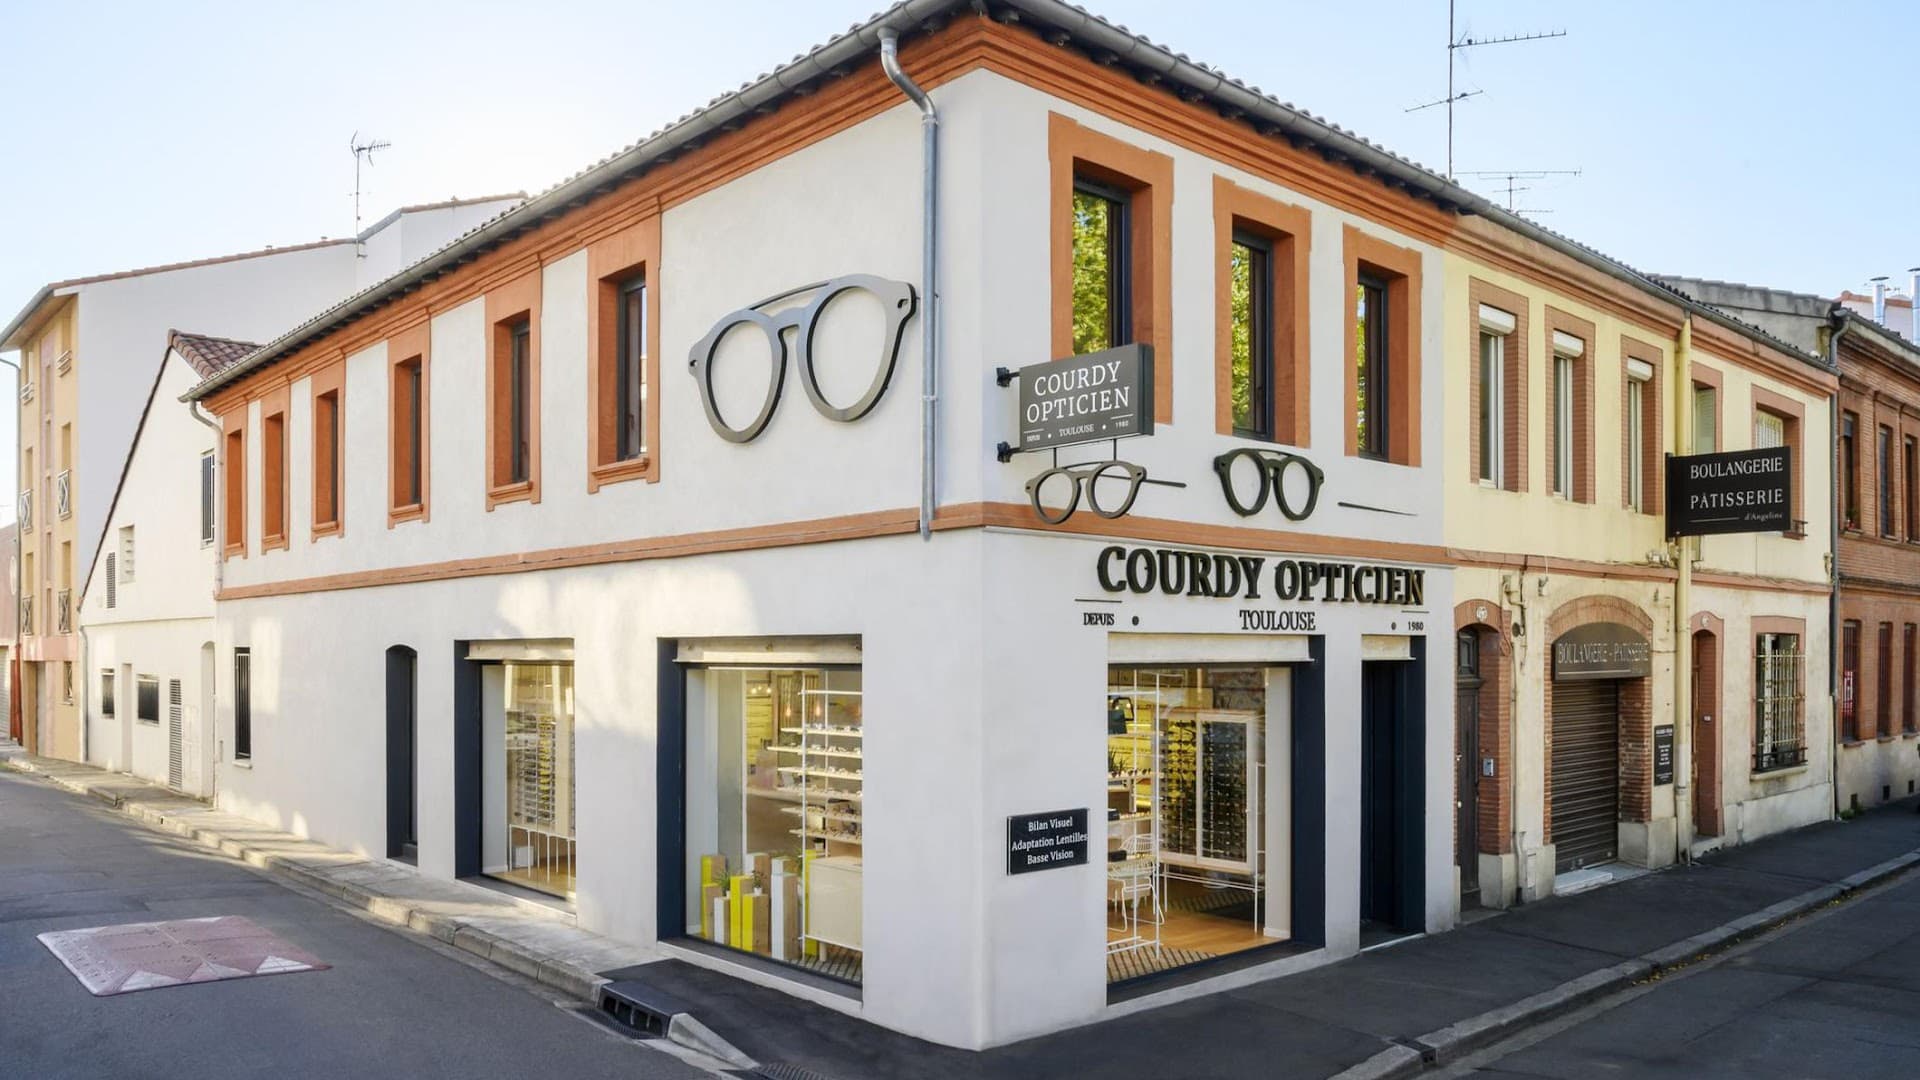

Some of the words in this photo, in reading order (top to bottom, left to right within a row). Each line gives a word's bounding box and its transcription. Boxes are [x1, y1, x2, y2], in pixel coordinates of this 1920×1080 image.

[1034, 361, 1121, 396] COURDY
[1026, 386, 1130, 423] OPTICIEN
[1059, 424, 1095, 437] TOULOUSE
[1690, 457, 1783, 479] BOULANGERIE
[1097, 546, 1265, 599] COURDY
[1274, 560, 1425, 606] OPTICIEN
[1083, 612, 1115, 626] DEPUIS
[1239, 609, 1316, 632] TOULOUSE
[1407, 621, 1424, 631] 1980
[1028, 821, 1048, 832] Bilan
[1050, 816, 1073, 829] Visuel
[1012, 837, 1054, 851] Adaptation
[1056, 832, 1088, 845] Lentilles
[1027, 854, 1049, 865] Basse
[1050, 849, 1074, 861] Vision
